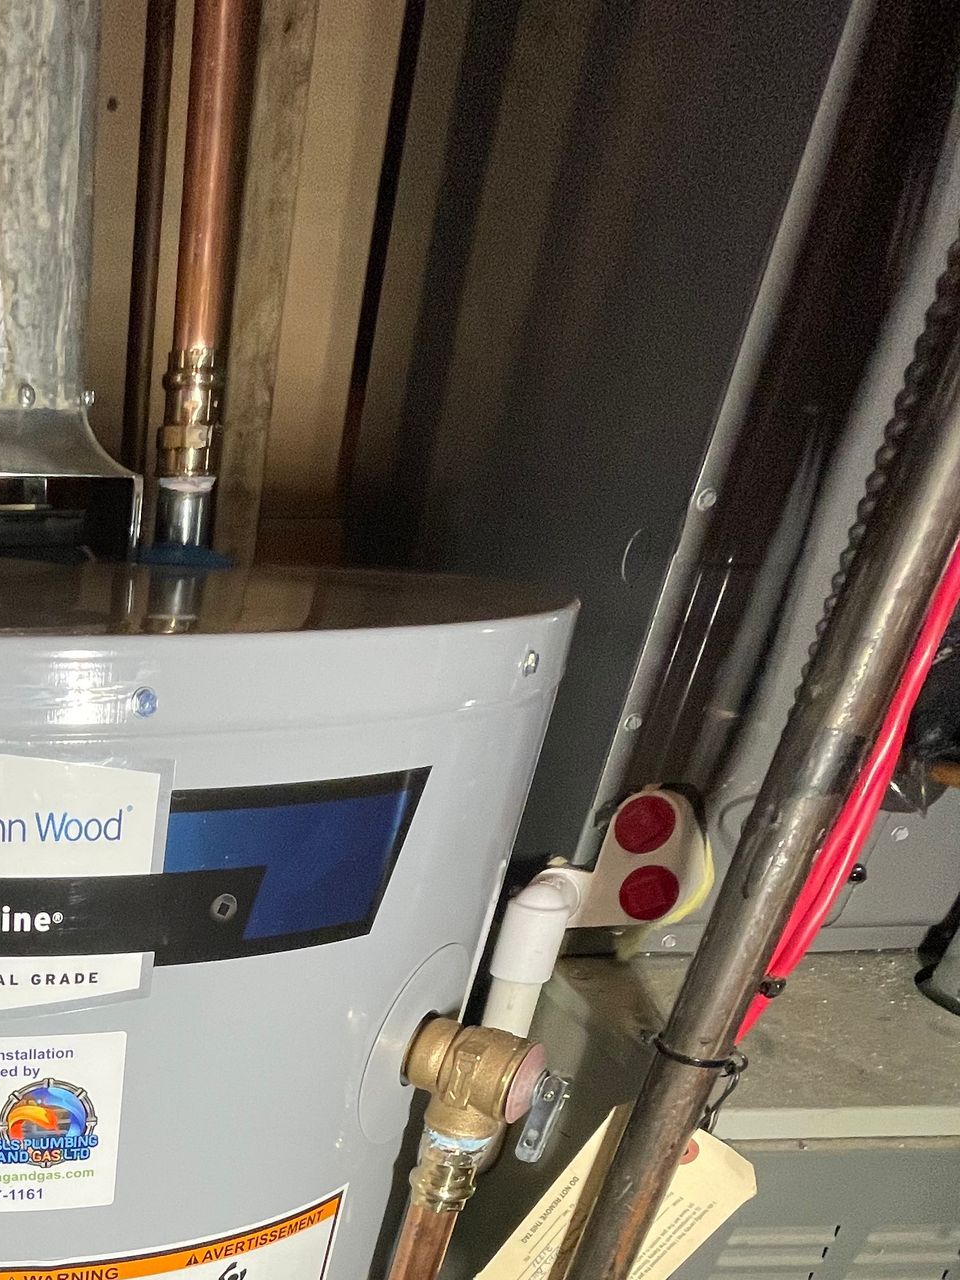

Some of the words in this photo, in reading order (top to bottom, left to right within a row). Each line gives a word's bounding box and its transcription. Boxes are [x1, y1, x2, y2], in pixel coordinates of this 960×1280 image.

[31, 972, 98, 985] GRADE
[23, 1066, 40, 1078] by
[23, 1135, 98, 1150] PLUMBING
[32, 1150, 61, 1162] GAS
[64, 1149, 90, 1160] LTD
[570, 1176, 579, 1186] DO
[560, 1186, 571, 1199] NOT
[540, 1198, 561, 1220] REMOVE
[530, 1221, 542, 1233] THIS
[201, 1210, 325, 1263] AVERTISSEMENT
[521, 1233, 533, 1243] TAG
